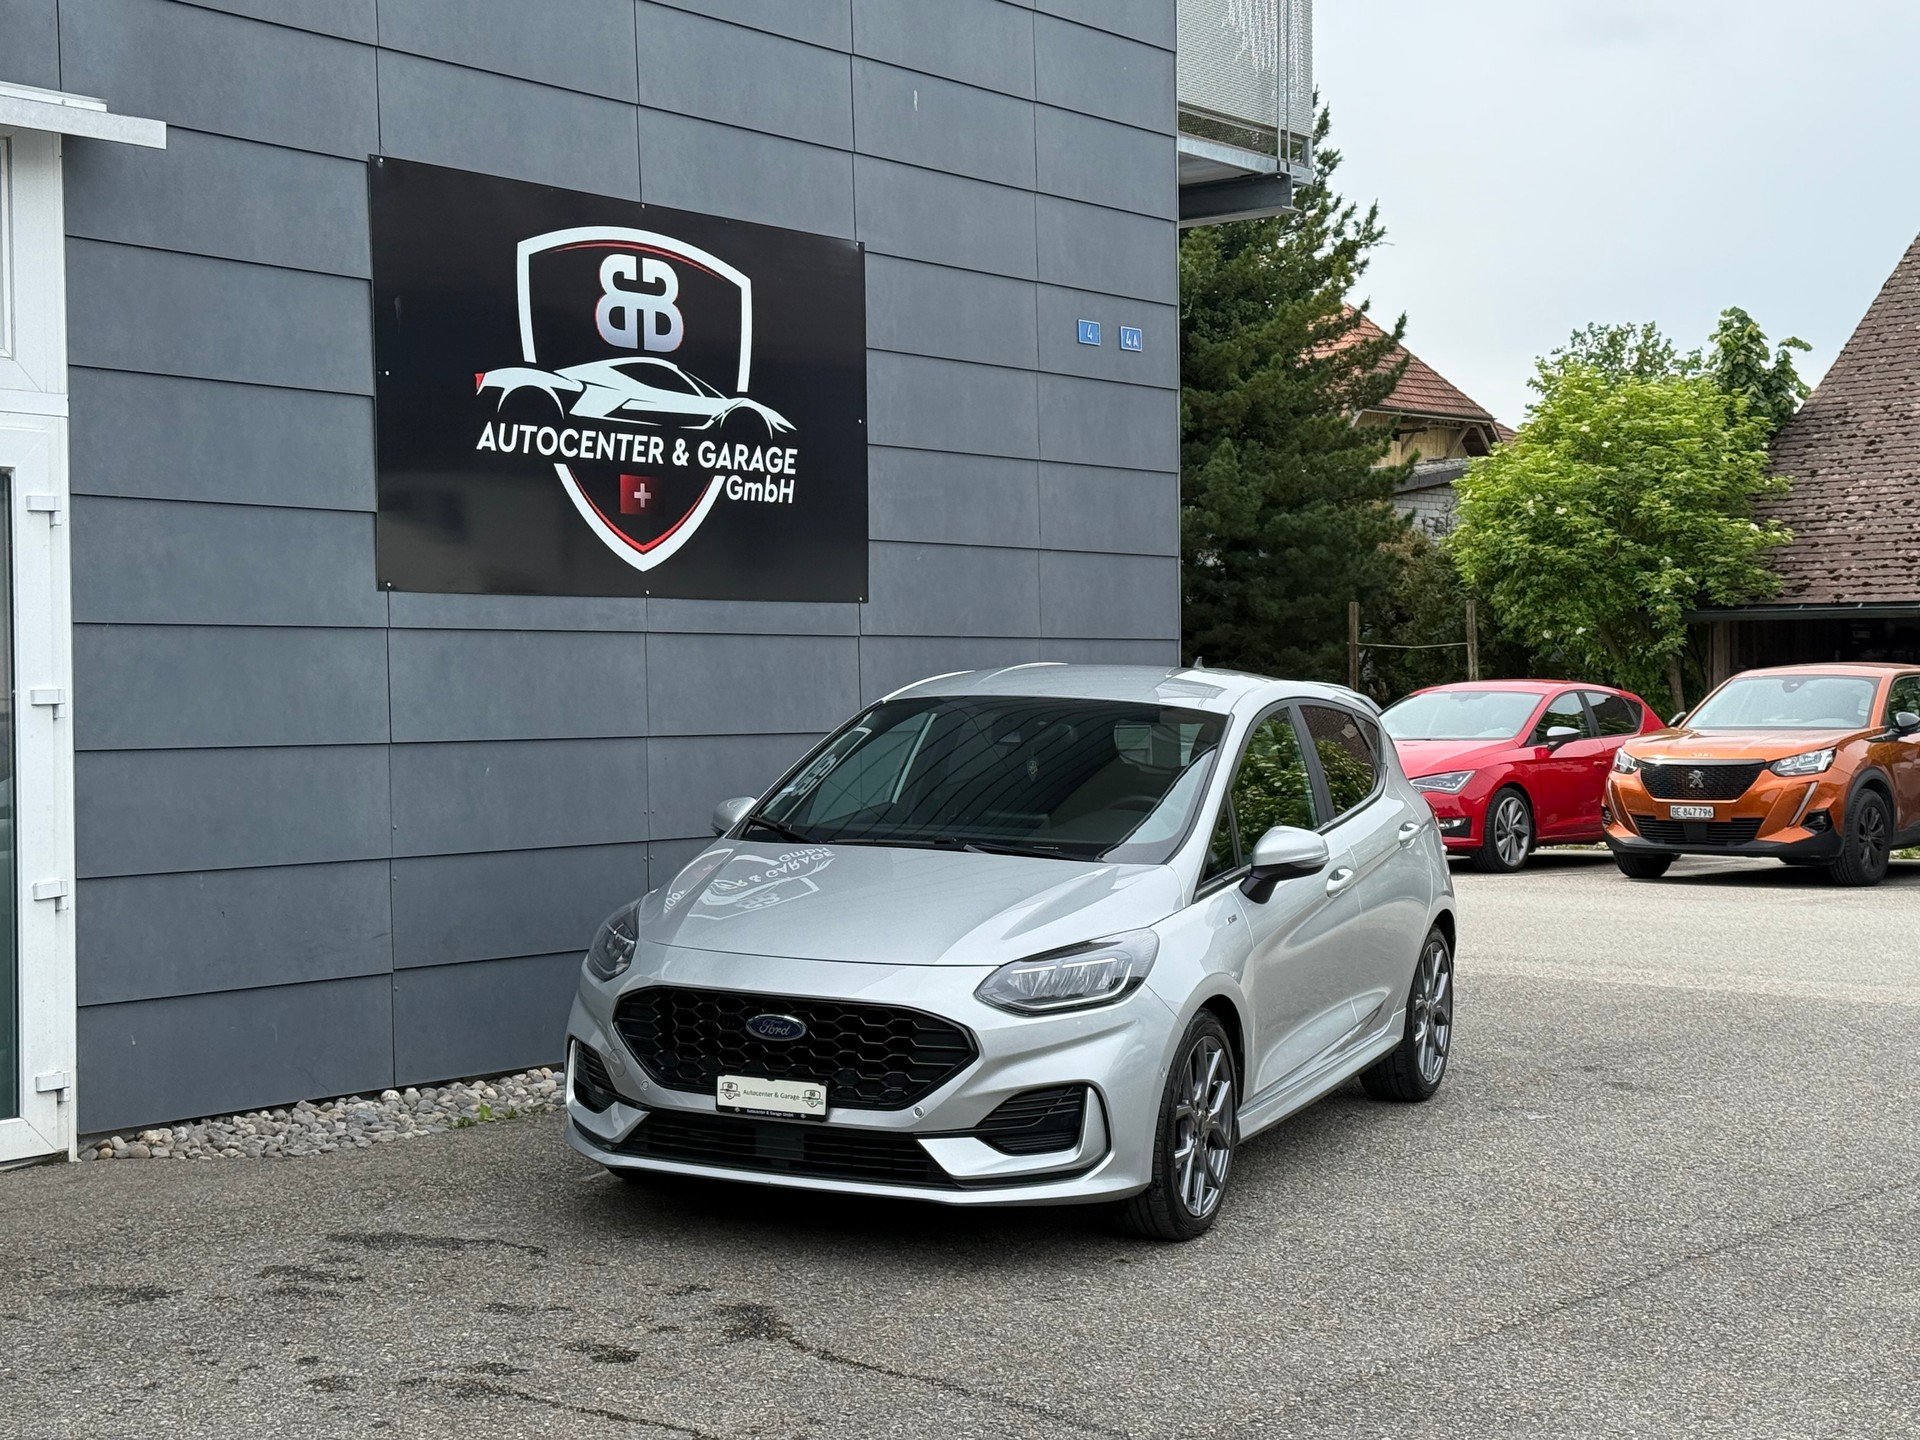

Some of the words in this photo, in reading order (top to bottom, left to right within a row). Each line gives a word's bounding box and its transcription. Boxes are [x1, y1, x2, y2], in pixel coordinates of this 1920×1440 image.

[1086, 324, 1093, 340] 4
[1125, 330, 1138, 346] 4A
[476, 421, 664, 465] AUTOCENTER
[672, 438, 690, 466] &
[697, 441, 798, 475] GARAGE
[726, 474, 795, 504] GmbH
[1672, 807, 1681, 816] BE
[758, 1019, 791, 1036] Ford
[743, 1089, 773, 1098] Autocenter
[780, 1092, 800, 1101] Garage
